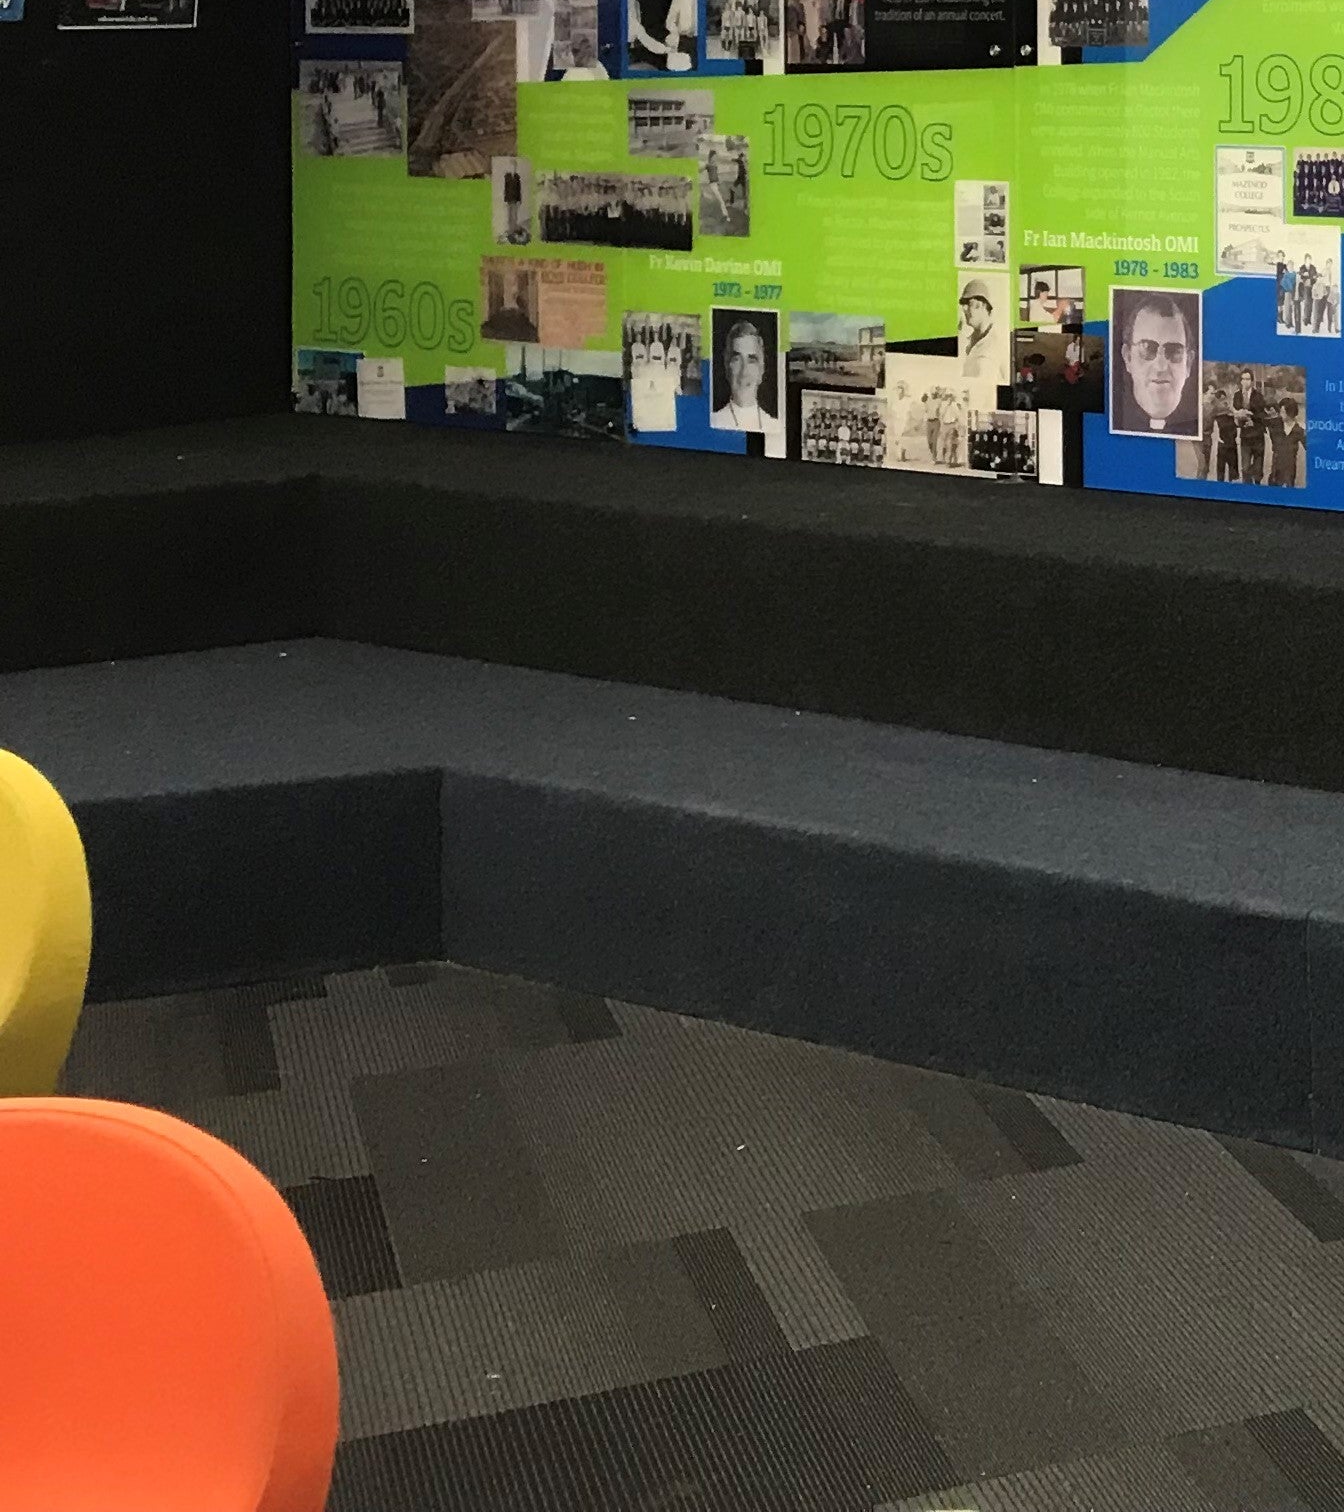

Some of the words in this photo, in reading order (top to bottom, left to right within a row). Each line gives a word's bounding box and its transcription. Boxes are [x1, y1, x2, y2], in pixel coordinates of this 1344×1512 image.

[762, 103, 954, 181] 1970s
[1024, 229, 1040, 246] Fr
[1042, 230, 1067, 247] Ian
[1070, 232, 1161, 251] Mackintosh
[1165, 236, 1198, 252] OMI
[1113, 259, 1148, 276] 1978
[1163, 262, 1199, 279] 1983
[309, 278, 474, 353] 1960s
[1325, 380, 1335, 391] In
